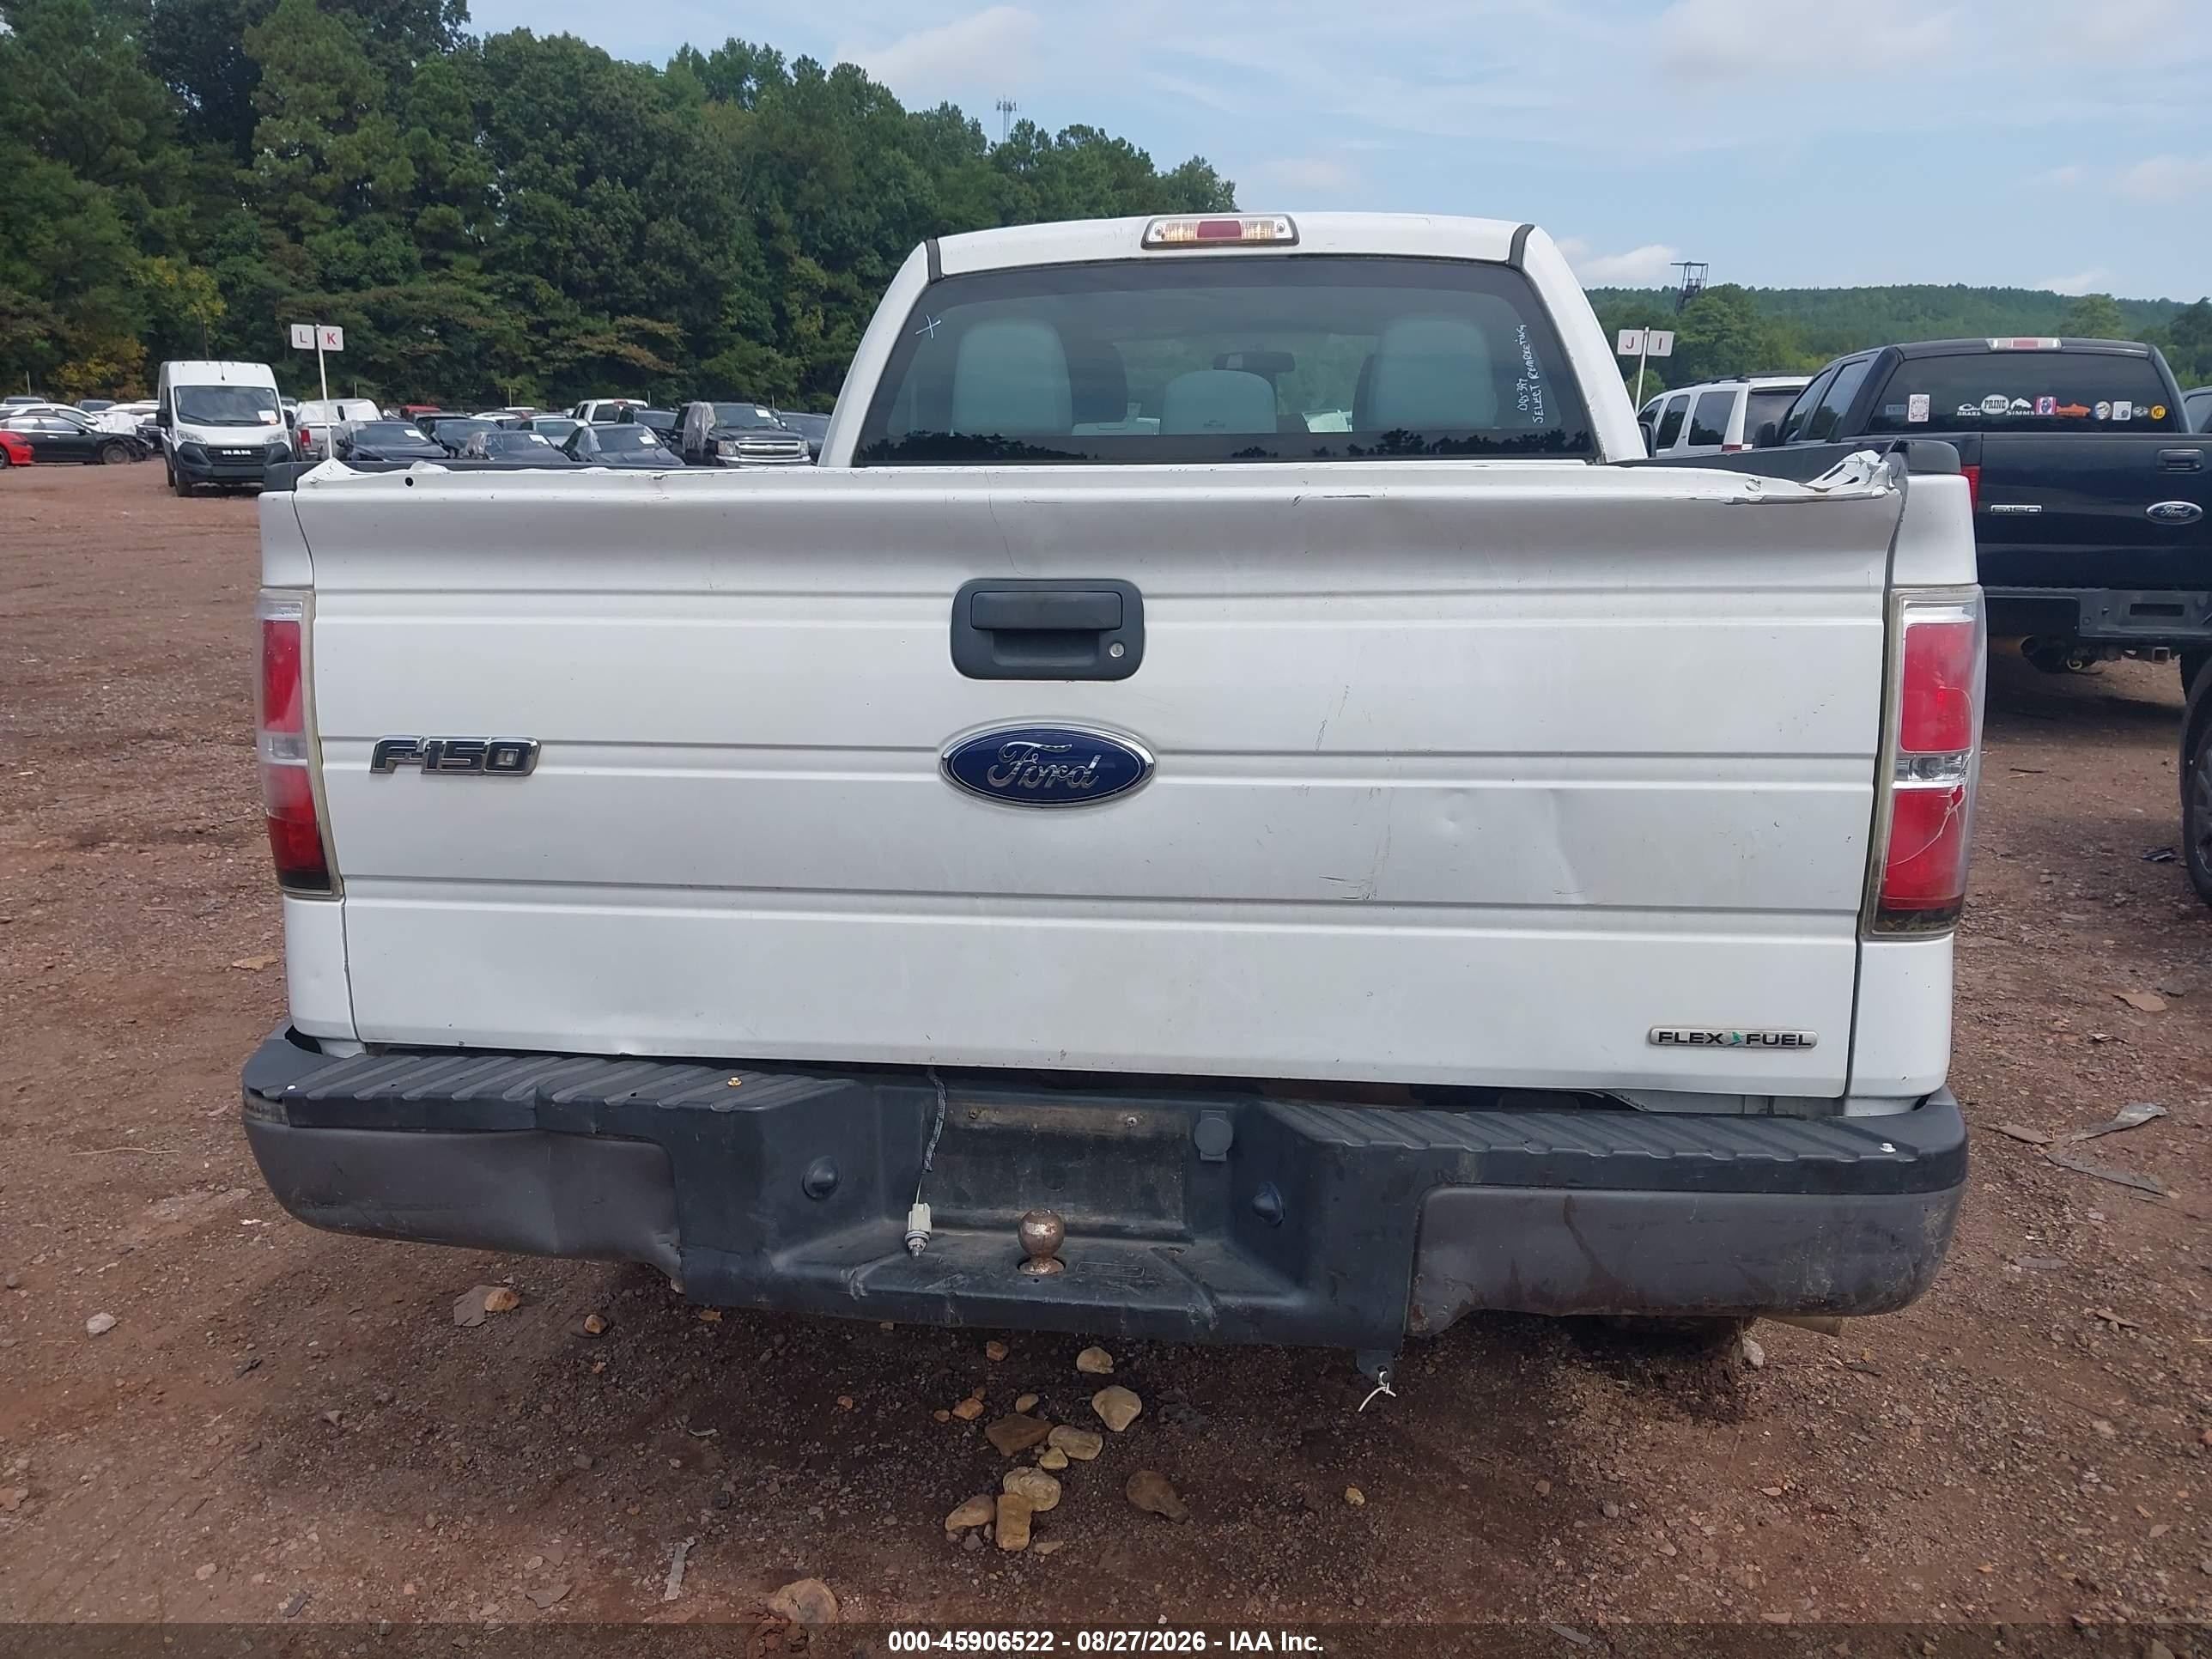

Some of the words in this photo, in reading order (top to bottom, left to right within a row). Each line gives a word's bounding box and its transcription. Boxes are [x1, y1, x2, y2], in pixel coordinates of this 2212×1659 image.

[299, 331, 308, 343] L
[326, 332, 337, 344] K
[1626, 336, 1635, 349] J
[1529, 385, 1544, 423] SELECT
[1984, 399, 2006, 410] PRINE
[988, 741, 1103, 789] Ford
[1658, 1031, 1724, 1045] FLEX
[1746, 1033, 1812, 1046] FUEL
